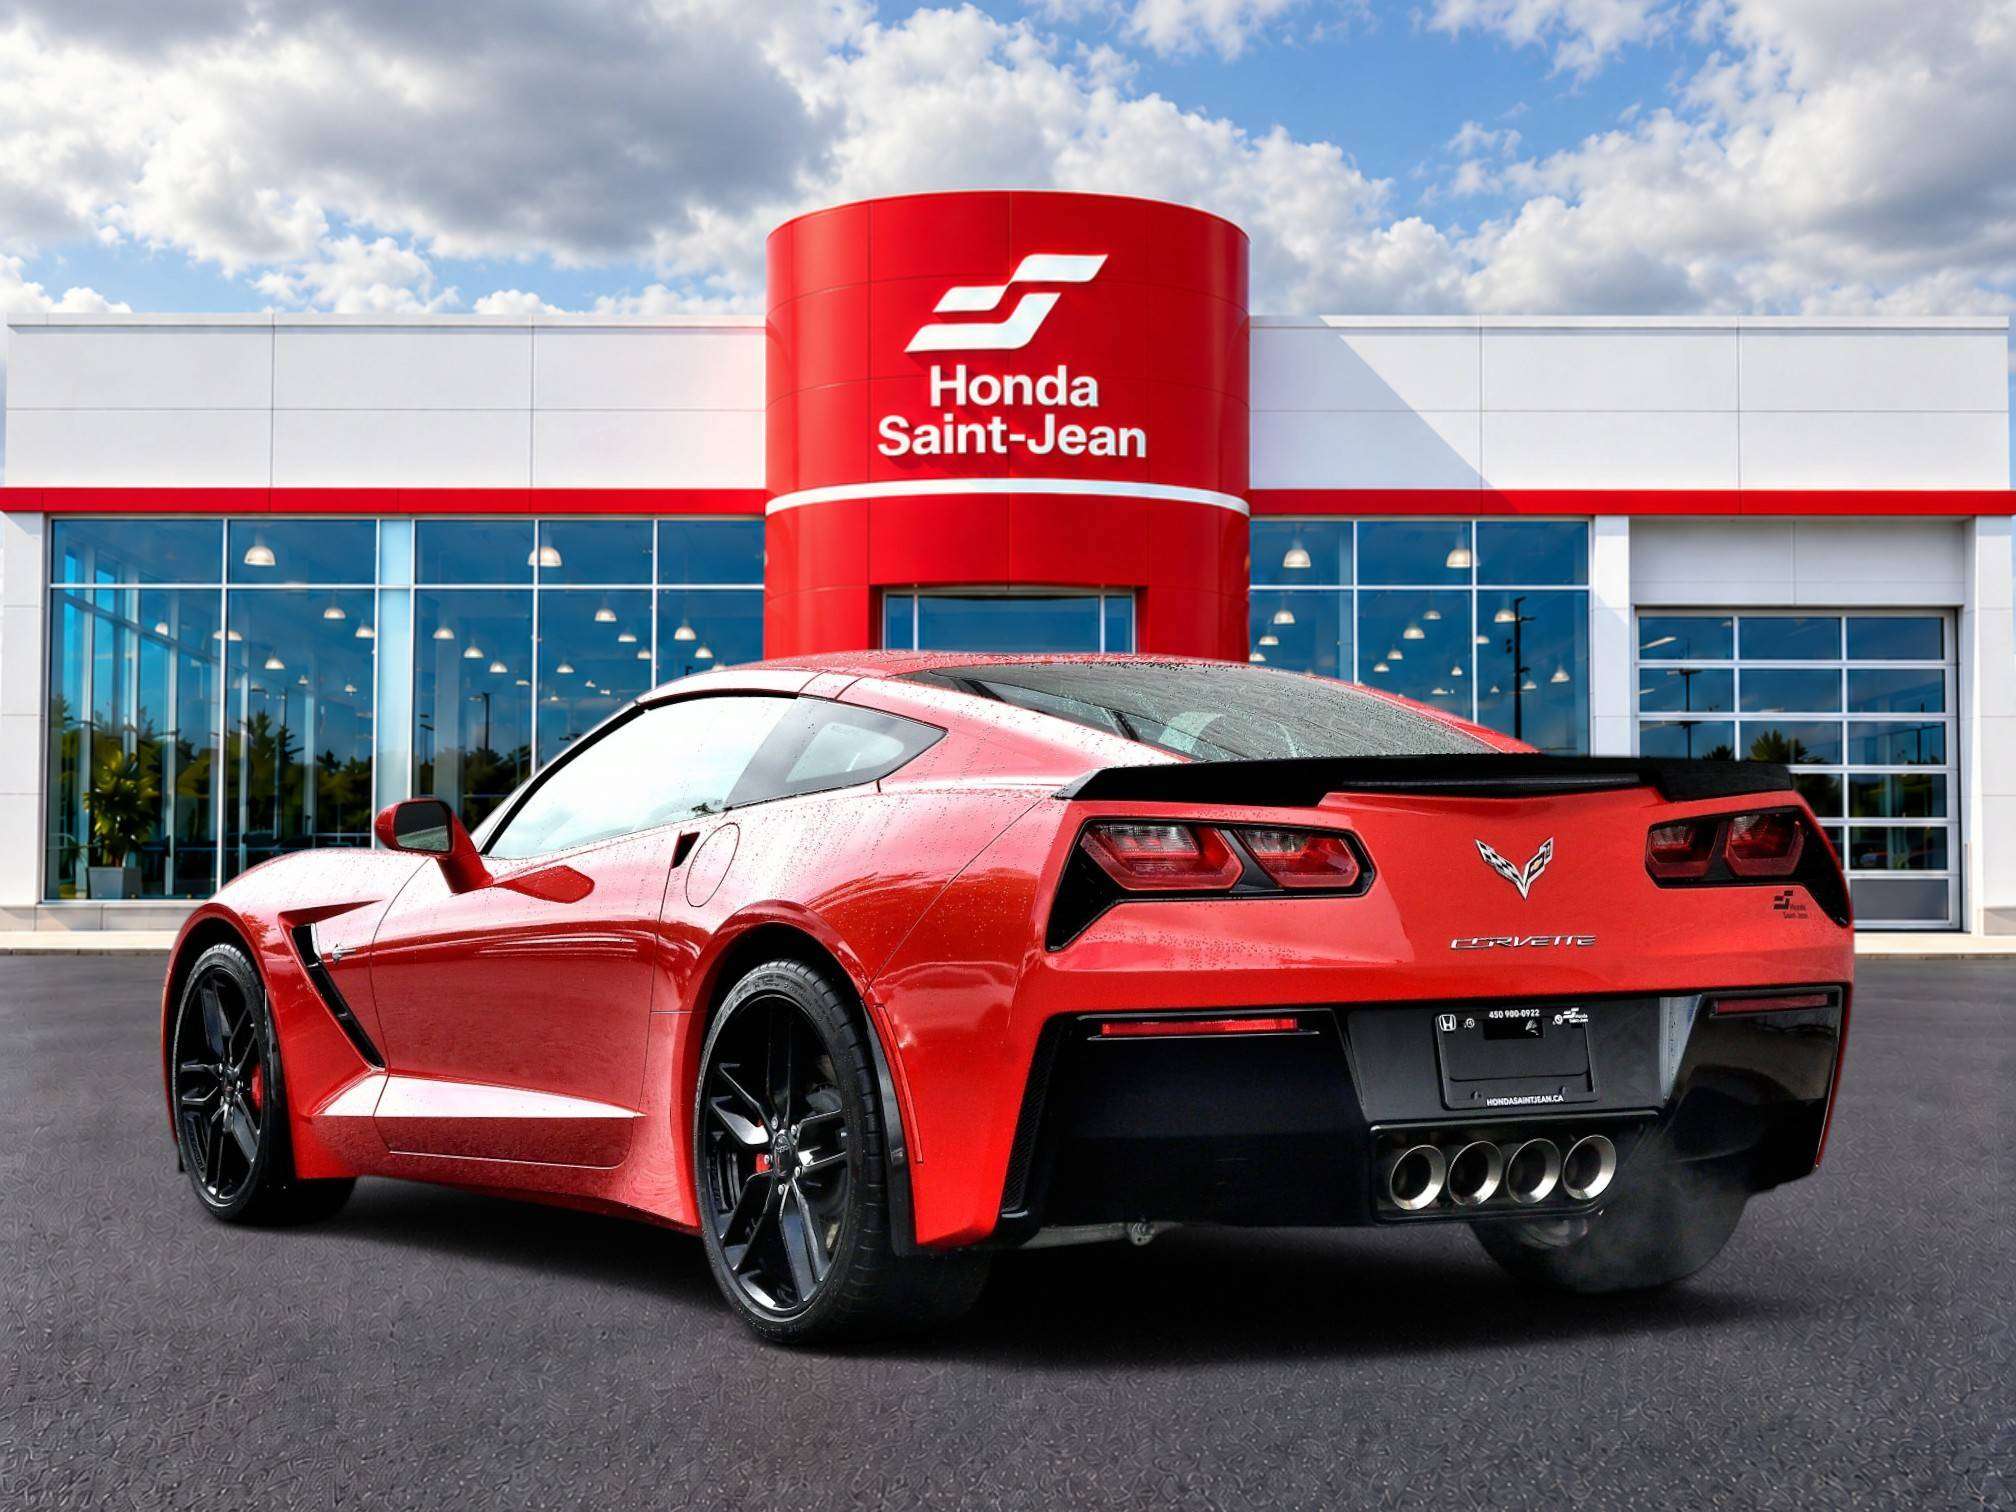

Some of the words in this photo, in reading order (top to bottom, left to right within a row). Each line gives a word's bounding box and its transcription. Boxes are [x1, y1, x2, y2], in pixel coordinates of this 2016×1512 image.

[930, 364, 1099, 407] Honda
[877, 413, 1147, 458] Saint-Jean
[1450, 935, 1596, 950] CORVETTE
[1488, 1010, 1504, 1019] 450
[1486, 1094, 1564, 1107] HONDASAINTJEAN.CA
